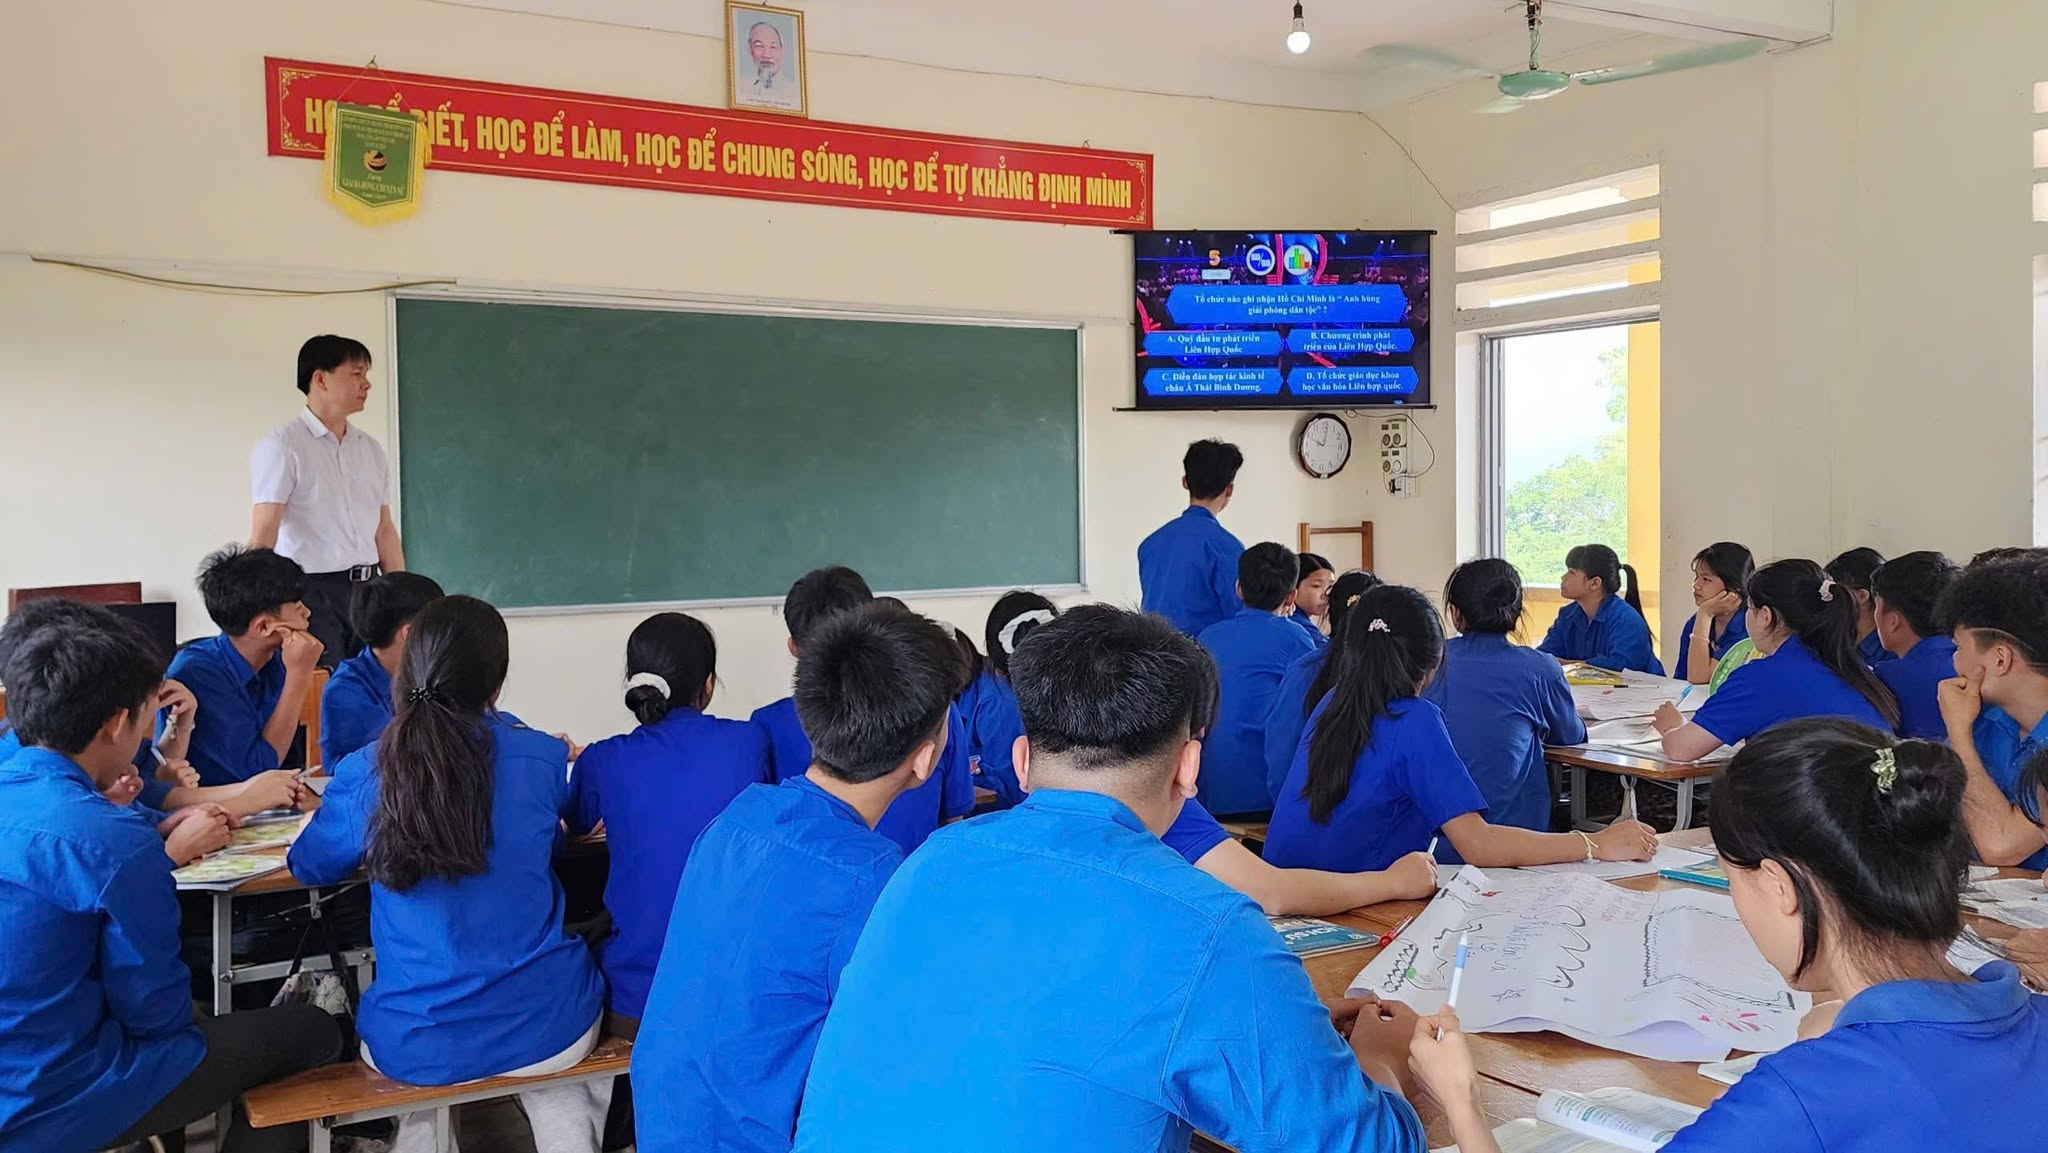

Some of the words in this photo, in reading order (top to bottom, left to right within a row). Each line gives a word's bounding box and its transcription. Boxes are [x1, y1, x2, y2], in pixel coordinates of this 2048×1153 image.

[477, 116, 526, 159] HỌC
[533, 110, 565, 157] ĐỂ
[571, 119, 629, 167] LÀM,
[636, 132, 681, 174] HỌC
[687, 127, 717, 172] ĐỂ
[722, 141, 795, 180] CHUNG
[801, 140, 864, 190] SỐNG,
[869, 156, 909, 196] HỌC
[913, 151, 939, 193] ĐỂ
[943, 163, 970, 202] TỰ
[972, 155, 1034, 201] KHẲNG
[1038, 172, 1081, 209] ĐỊNH
[1086, 173, 1132, 209] MÌNH
[1208, 249, 1221, 266] 5
[1242, 295, 1255, 304] ghi
[1256, 295, 1276, 304] nhận
[1306, 295, 1327, 303] Minh
[1343, 295, 1360, 303] Anh
[1222, 335, 1240, 344] phát
[1373, 332, 1391, 340] phát
[1185, 345, 1202, 353] Liên
[1339, 342, 1357, 350] Liên
[1306, 372, 1315, 380] D.
[1381, 371, 1400, 379] khoa
[1194, 383, 1212, 391] Thái
